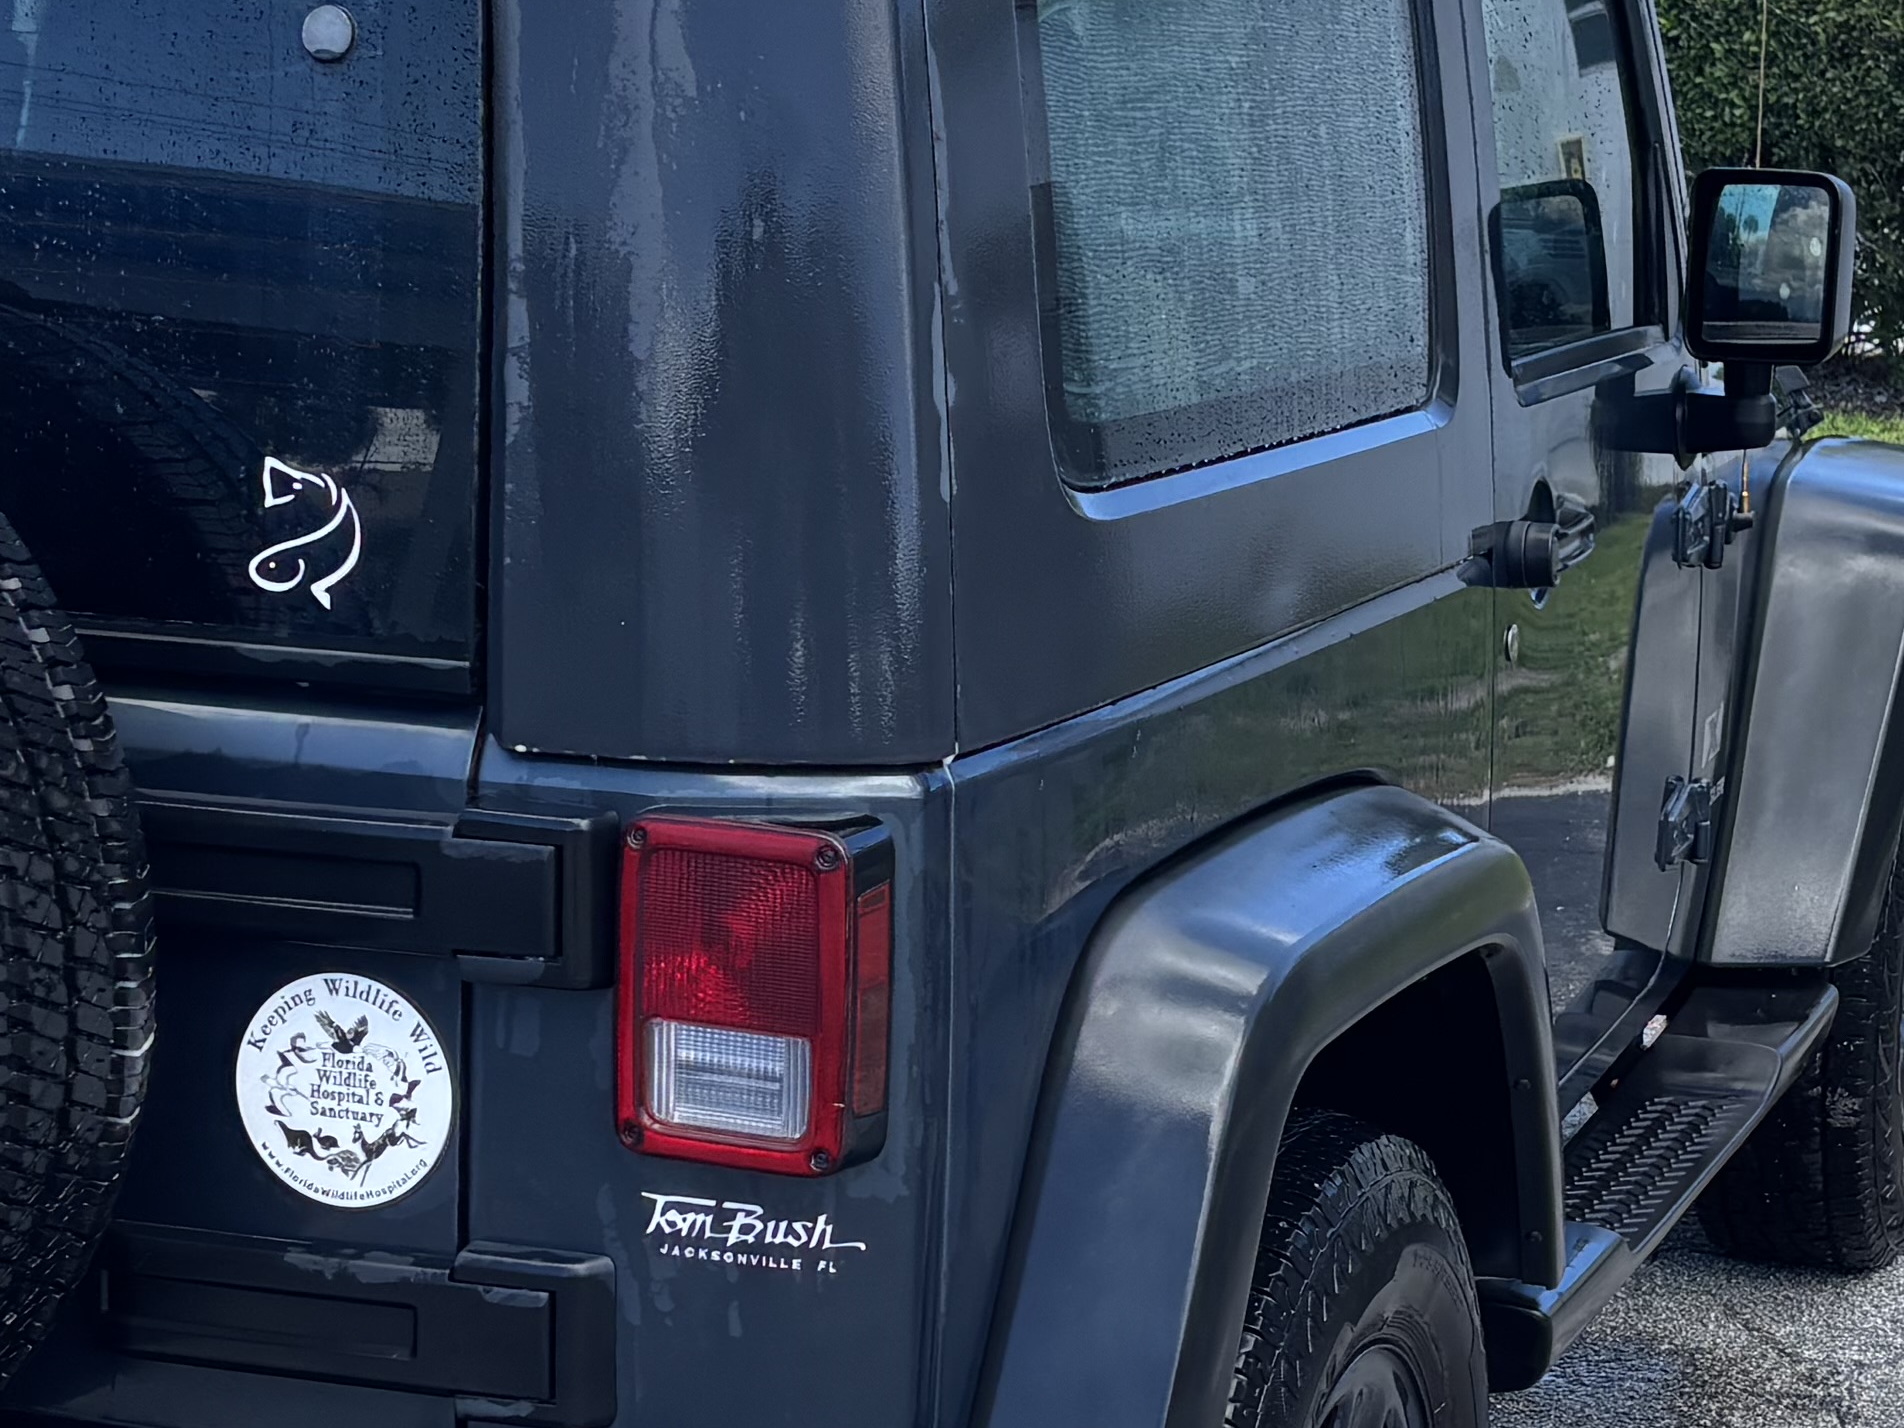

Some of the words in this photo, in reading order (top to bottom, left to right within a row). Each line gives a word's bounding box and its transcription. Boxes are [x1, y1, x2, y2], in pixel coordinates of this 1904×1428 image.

[247, 988, 317, 1052] Keeping
[323, 977, 404, 1022] Wildlife
[409, 1021, 443, 1076] Wild
[321, 1052, 373, 1072] Florida
[315, 1068, 378, 1089] Wildlife
[309, 1083, 370, 1106] Hospital
[374, 1091, 384, 1106] &
[309, 1101, 384, 1128] Sanctuary
[641, 1191, 731, 1239] Tom
[721, 1201, 867, 1250] Bush
[659, 1243, 802, 1271] JACKSONVILLE
[817, 1260, 838, 1273] FL
